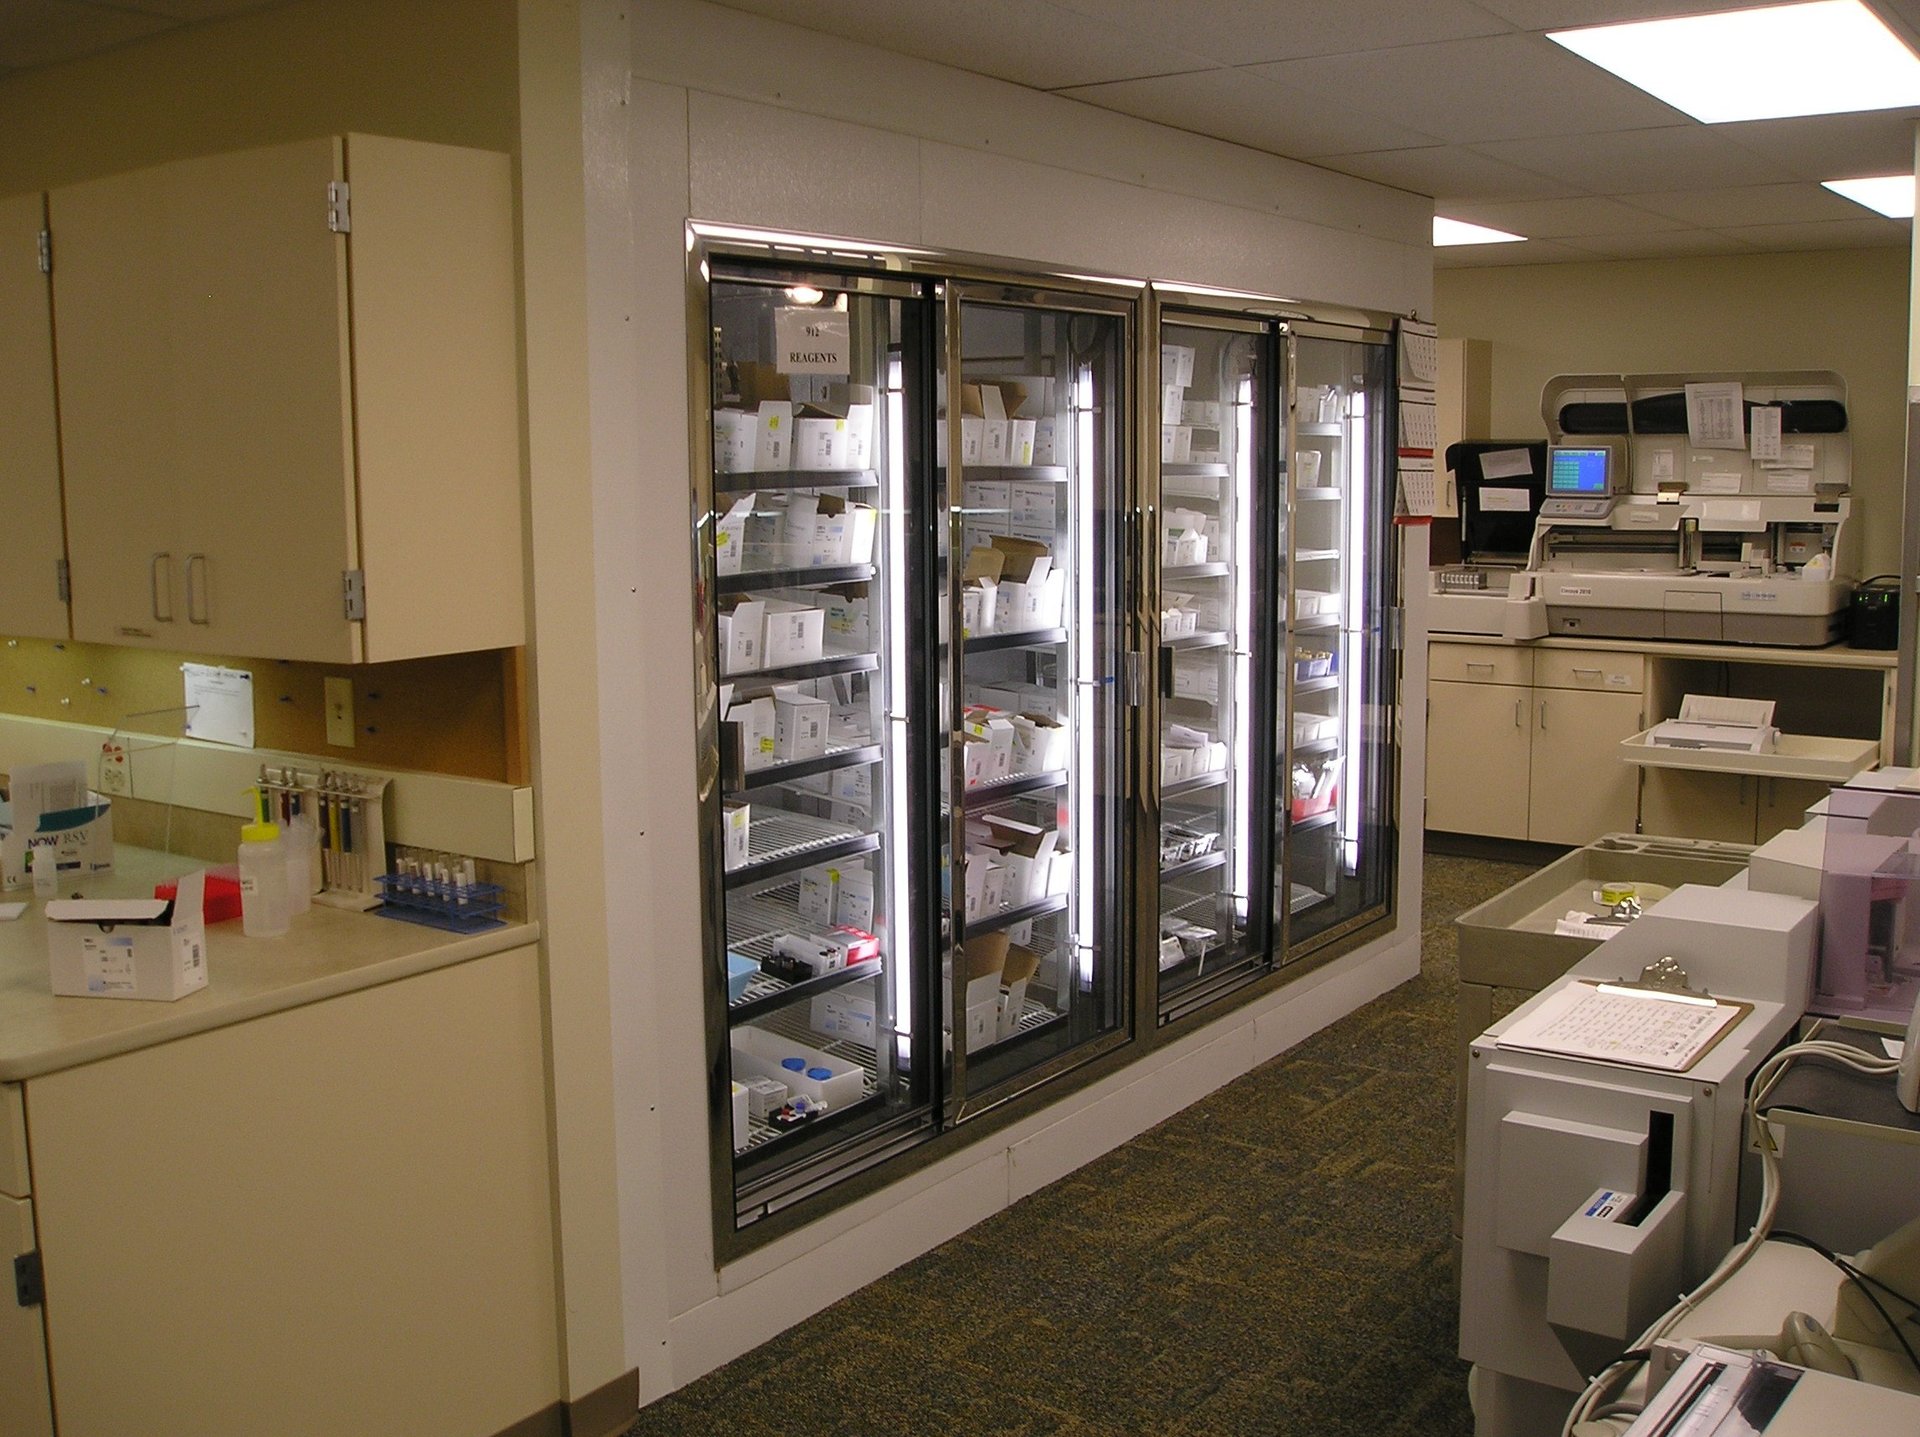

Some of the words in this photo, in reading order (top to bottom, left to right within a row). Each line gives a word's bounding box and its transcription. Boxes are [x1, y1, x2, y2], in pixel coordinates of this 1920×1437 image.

[805, 326, 820, 337] 912
[789, 351, 838, 363] REAGENTS
[28, 835, 59, 849] NOW
